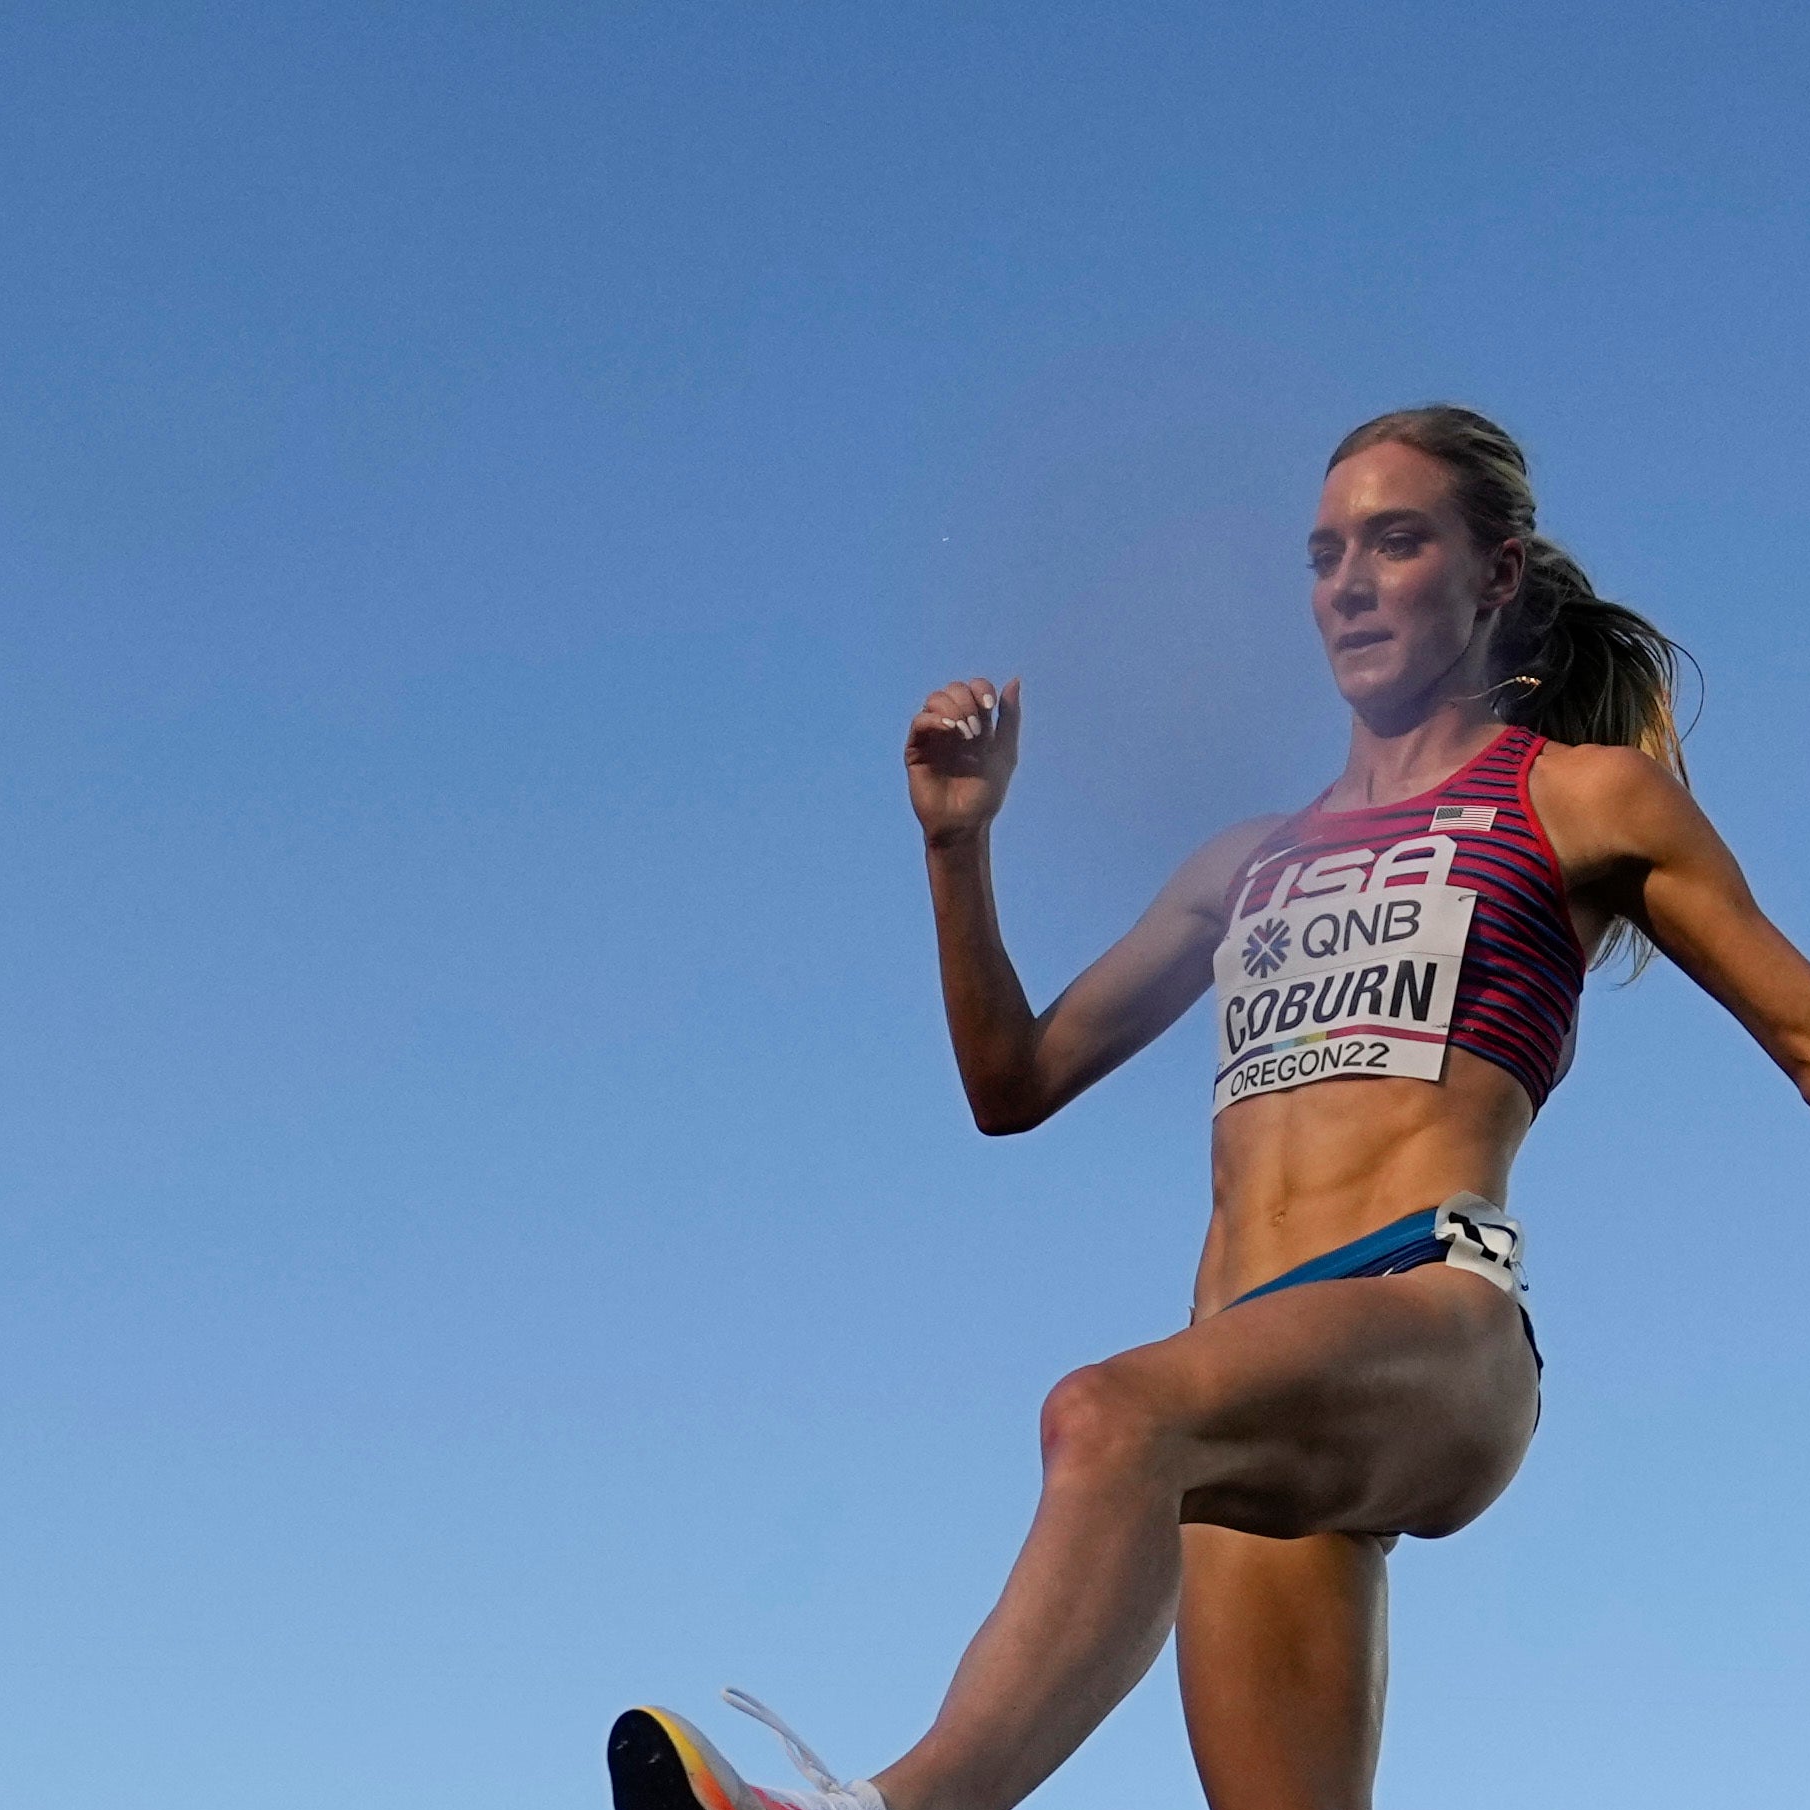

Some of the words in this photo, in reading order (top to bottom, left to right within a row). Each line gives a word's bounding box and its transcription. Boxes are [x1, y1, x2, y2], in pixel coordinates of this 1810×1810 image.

[1230, 834, 1458, 921] USA
[1301, 900, 1422, 959] QNB
[1225, 959, 1438, 1055] COBURN
[1230, 1041, 1391, 1097] OREGON22
